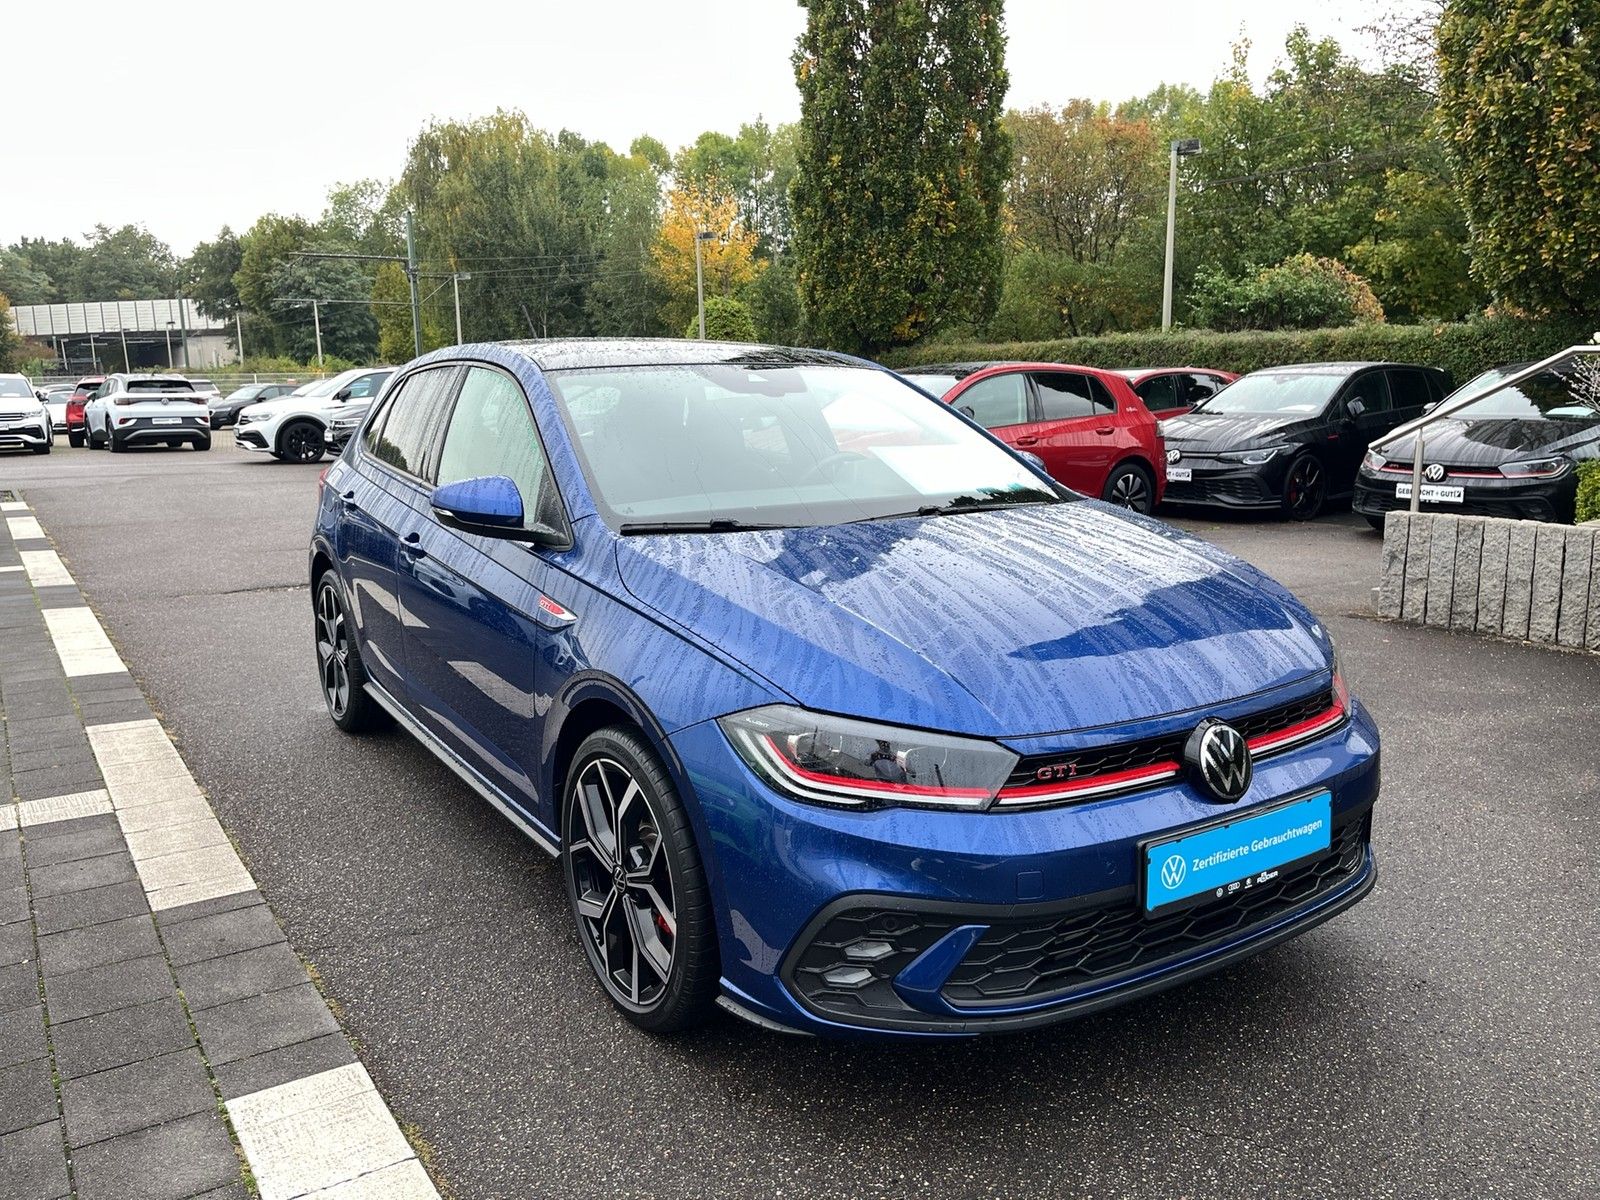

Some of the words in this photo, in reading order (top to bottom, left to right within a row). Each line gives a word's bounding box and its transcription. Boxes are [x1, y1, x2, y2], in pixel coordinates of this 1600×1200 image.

[1425, 464, 1444, 480] VW
[1398, 488, 1434, 496] GEBCHT
[1037, 763, 1077, 779] GTI
[1201, 725, 1246, 799] VW
[1192, 845, 1249, 872] Zertifizierte
[1251, 819, 1323, 852] Gebrauchtwagen
[1161, 855, 1186, 889] VW
